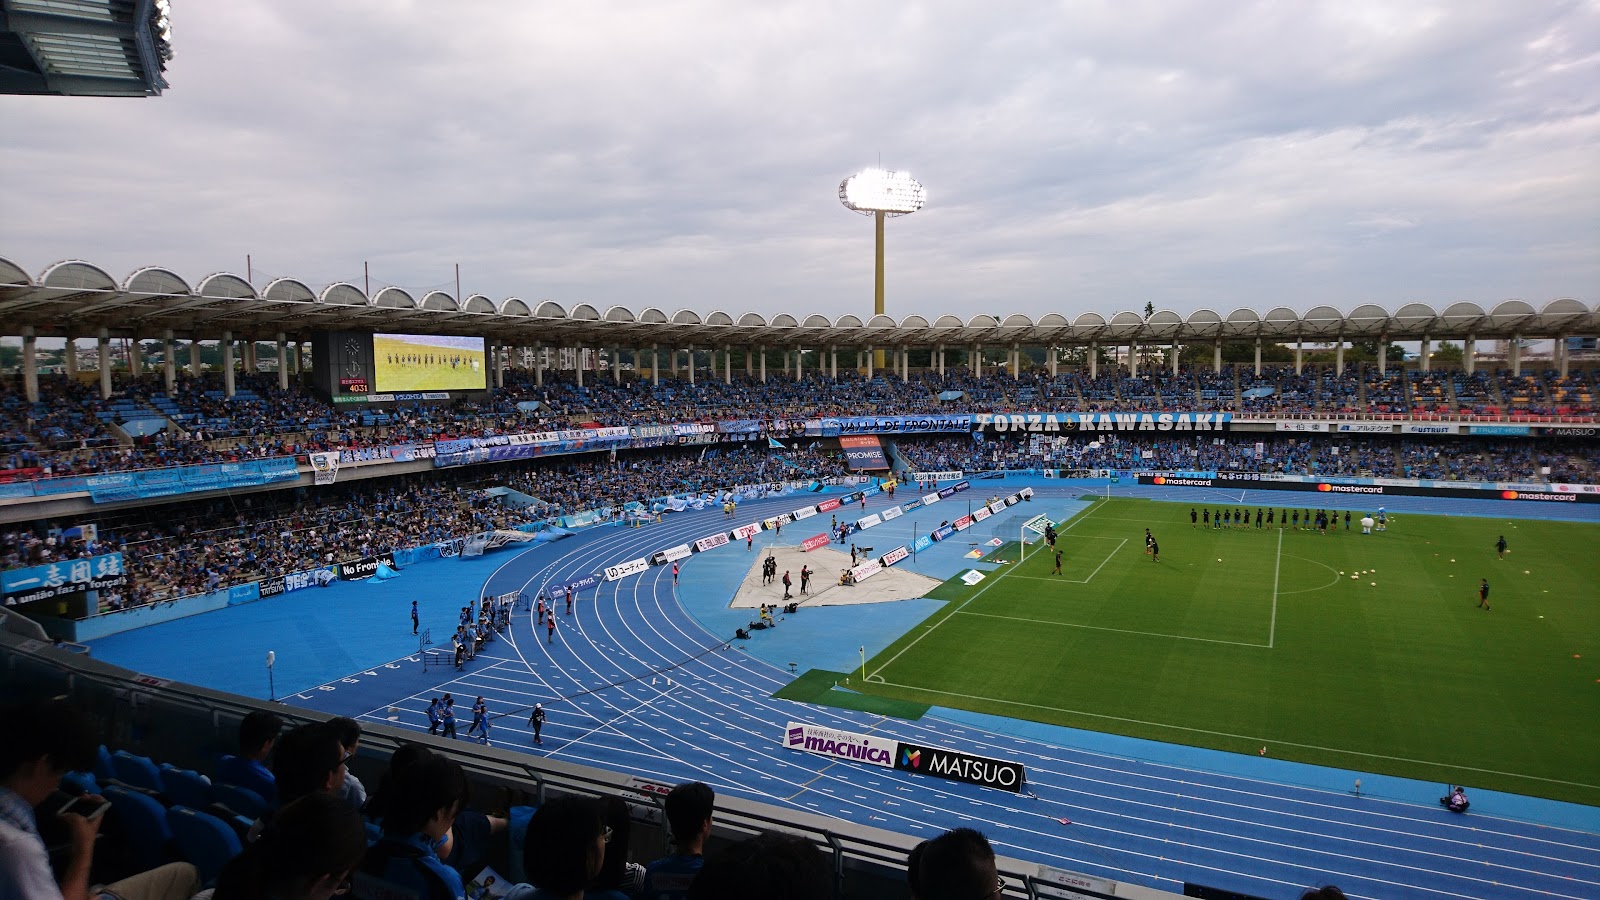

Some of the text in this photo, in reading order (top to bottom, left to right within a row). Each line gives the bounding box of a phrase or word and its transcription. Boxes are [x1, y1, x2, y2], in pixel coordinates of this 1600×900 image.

[349, 384, 368, 392] 4031
[883, 420, 900, 431] DE
[903, 418, 970, 431] FRONTALE
[975, 413, 1224, 432] FORZA KAWASAKI
[679, 424, 715, 434] MANABU
[1556, 428, 1596, 436] MATSUO
[846, 451, 882, 459] PROMISE
[1166, 478, 1211, 486] mastercard
[1332, 485, 1383, 493] mastercard
[1518, 493, 1576, 501] mastercard
[739, 525, 757, 537] FDK
[343, 565, 355, 576] No
[619, 562, 645, 576] ユーディー
[6, 596, 17, 605] A
[20, 590, 55, 604] união
[57, 585, 75, 595] faz
[260, 584, 284, 596] TATSUYA
[929, 752, 1016, 786] MATSUO
